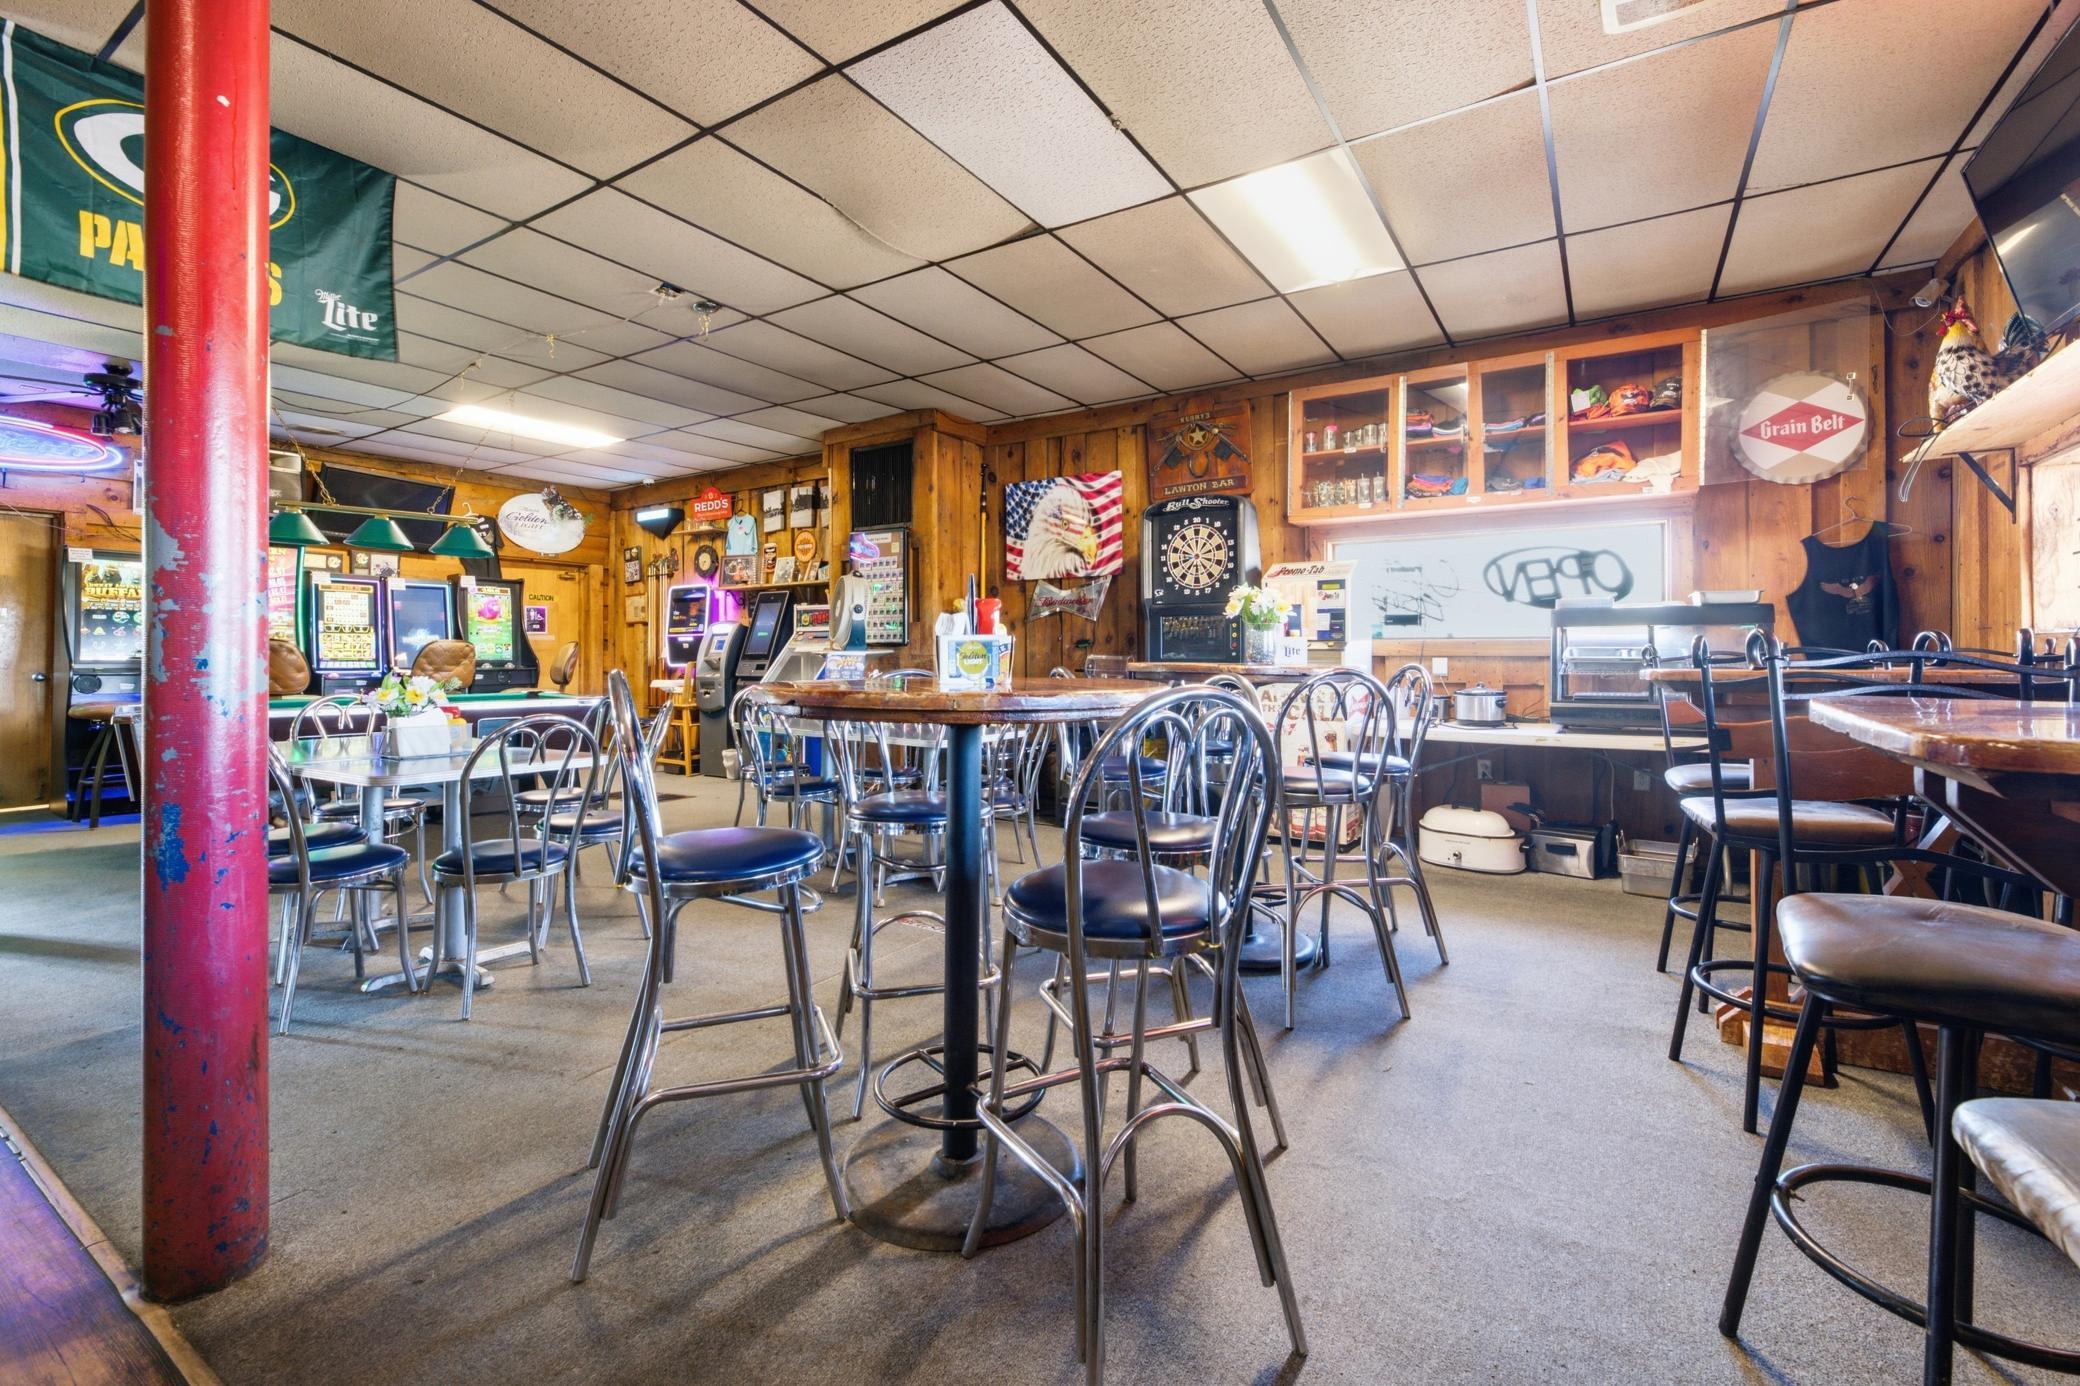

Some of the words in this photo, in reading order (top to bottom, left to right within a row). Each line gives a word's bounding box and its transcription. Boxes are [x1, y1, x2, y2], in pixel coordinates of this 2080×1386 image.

[318, 300, 378, 331] Lite
[1761, 420, 1807, 439] Grain
[1811, 414, 1845, 434] Belt
[1164, 482, 1207, 495] LAWTON
[1212, 479, 1234, 489] BAR
[694, 497, 728, 512] REDD'S
[1163, 500, 1189, 512] Bull
[1284, 646, 1301, 657] Lite
